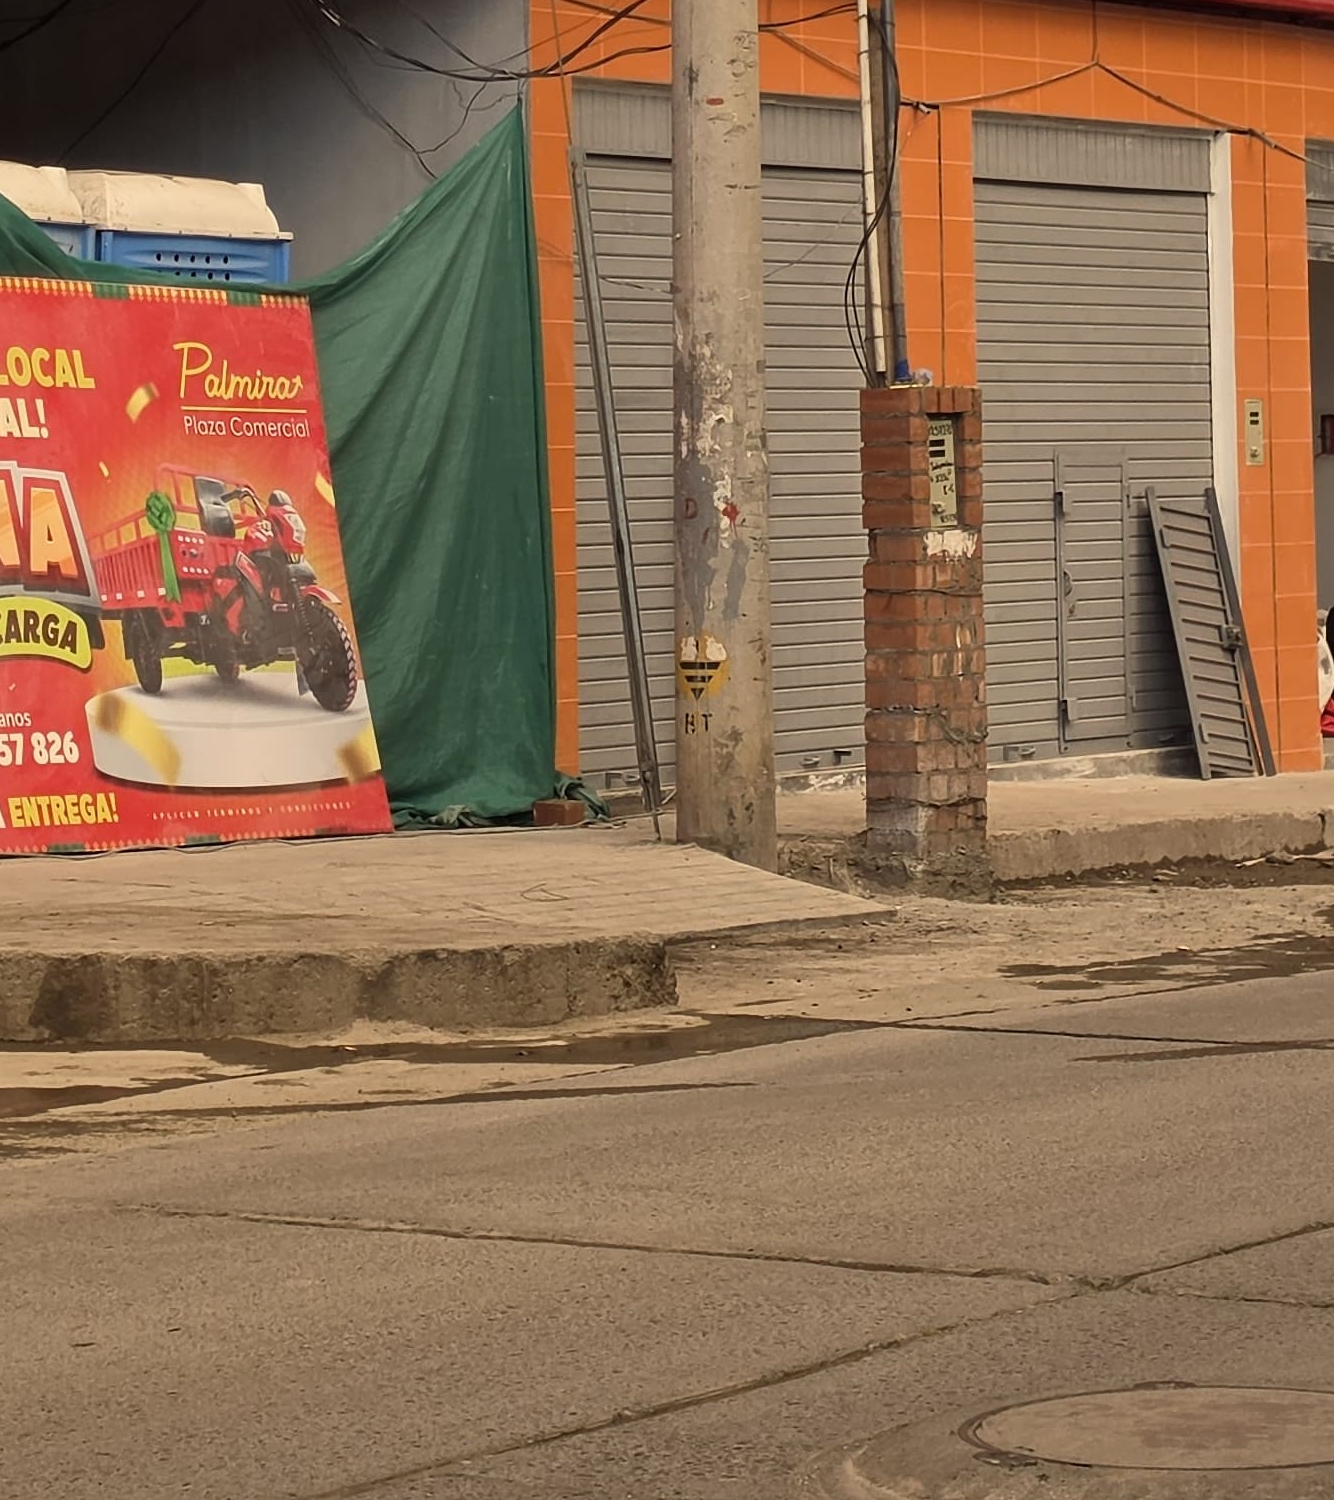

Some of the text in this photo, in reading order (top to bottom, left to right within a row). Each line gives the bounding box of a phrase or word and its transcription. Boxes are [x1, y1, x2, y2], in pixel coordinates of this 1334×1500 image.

[172, 341, 304, 400] Palmira
[183, 415, 311, 438] Plaza Comercial
[30, 731, 80, 765] 826
[7, 792, 119, 828] ENTREGA!
